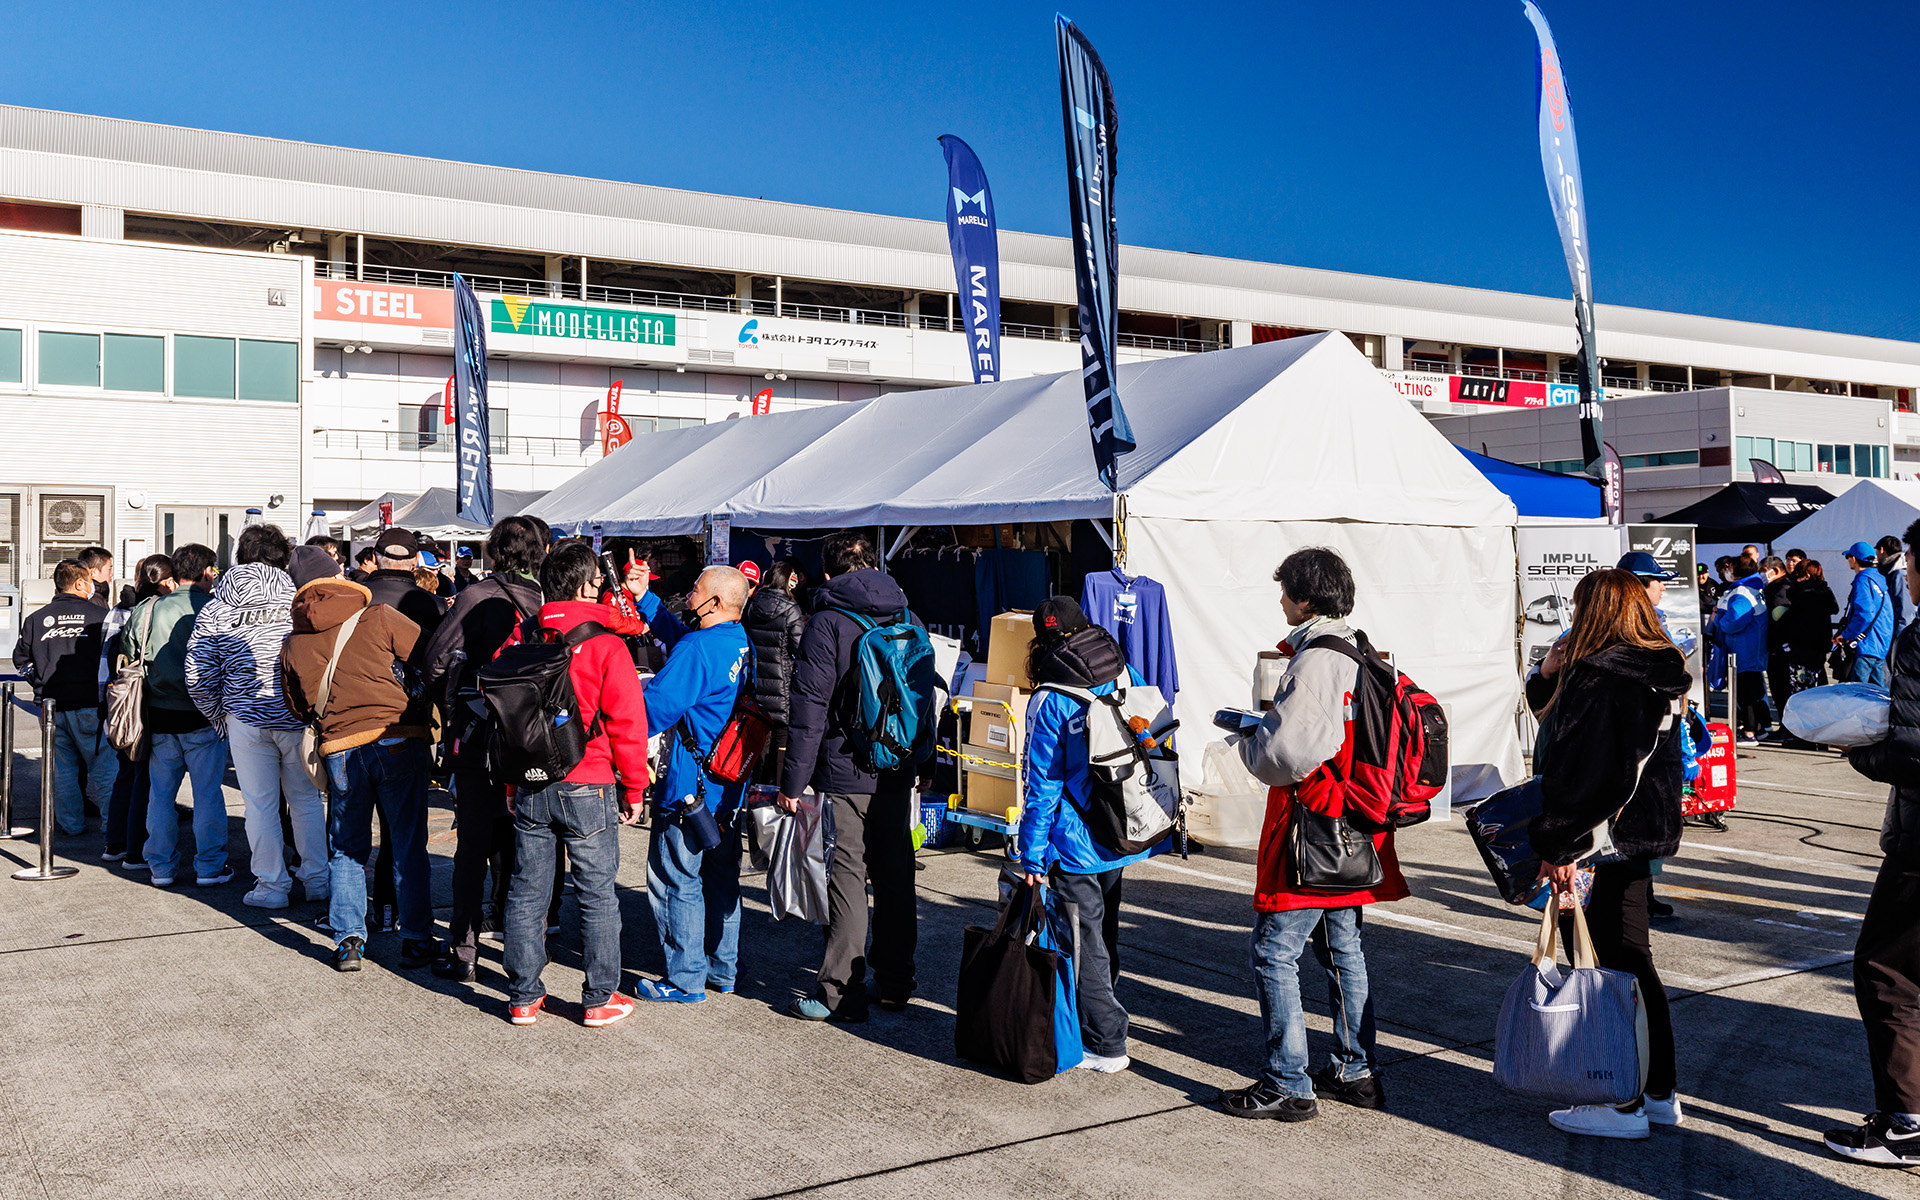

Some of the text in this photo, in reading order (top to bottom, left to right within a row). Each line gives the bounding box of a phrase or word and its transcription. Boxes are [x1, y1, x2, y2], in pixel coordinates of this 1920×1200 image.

[958, 215, 988, 227] MARELLI
[270, 291, 283, 306] 4
[336, 287, 422, 320] STEEL
[538, 310, 664, 345] MODELLISTA
[762, 333, 796, 343] 株式会社
[798, 335, 822, 345] トヨタ
[610, 386, 619, 414] OTUL
[1463, 382, 1505, 402] AKTIO
[1652, 537, 1673, 557] Z
[1543, 553, 1598, 563] IMPUL
[736, 751, 754, 778] NISSAN
